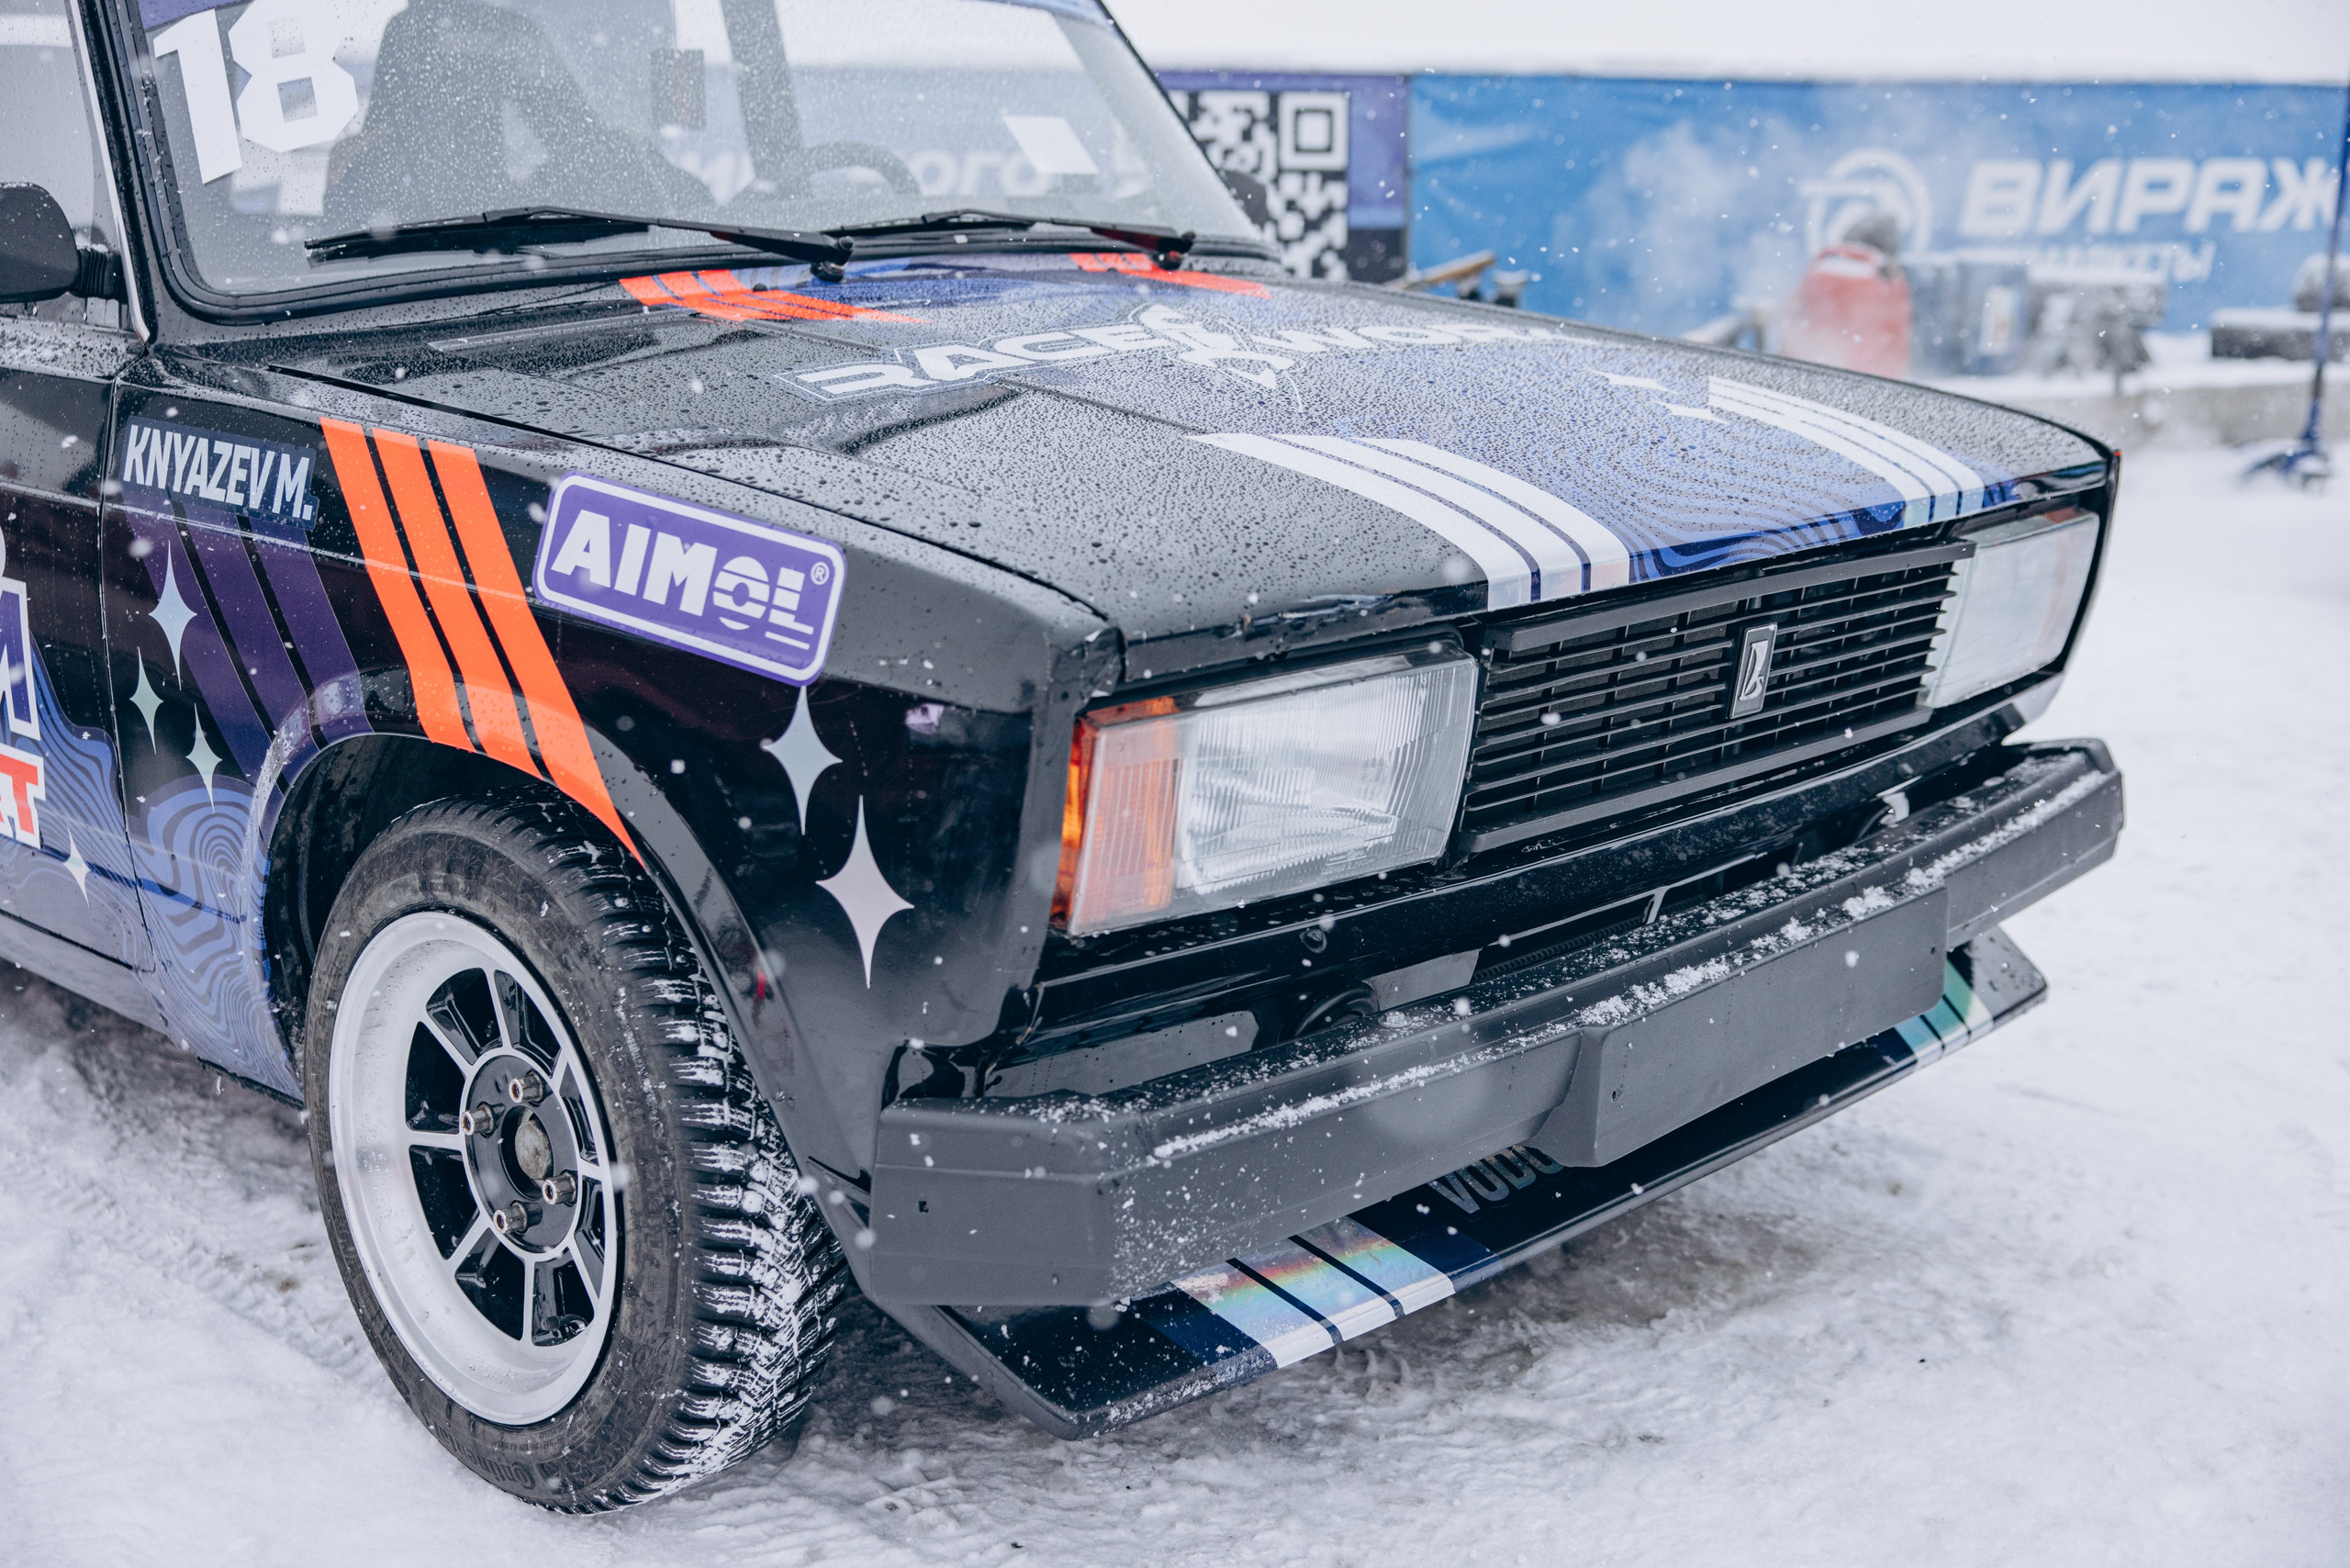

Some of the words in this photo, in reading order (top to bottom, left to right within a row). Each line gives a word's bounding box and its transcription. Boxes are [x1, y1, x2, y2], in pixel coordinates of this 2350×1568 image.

[152, 0, 359, 184] 18
[1957, 157, 2340, 235] ВИРАЖ
[796, 324, 1173, 395] RACE
[123, 424, 275, 510] KNYAZEV
[272, 454, 313, 521] M.
